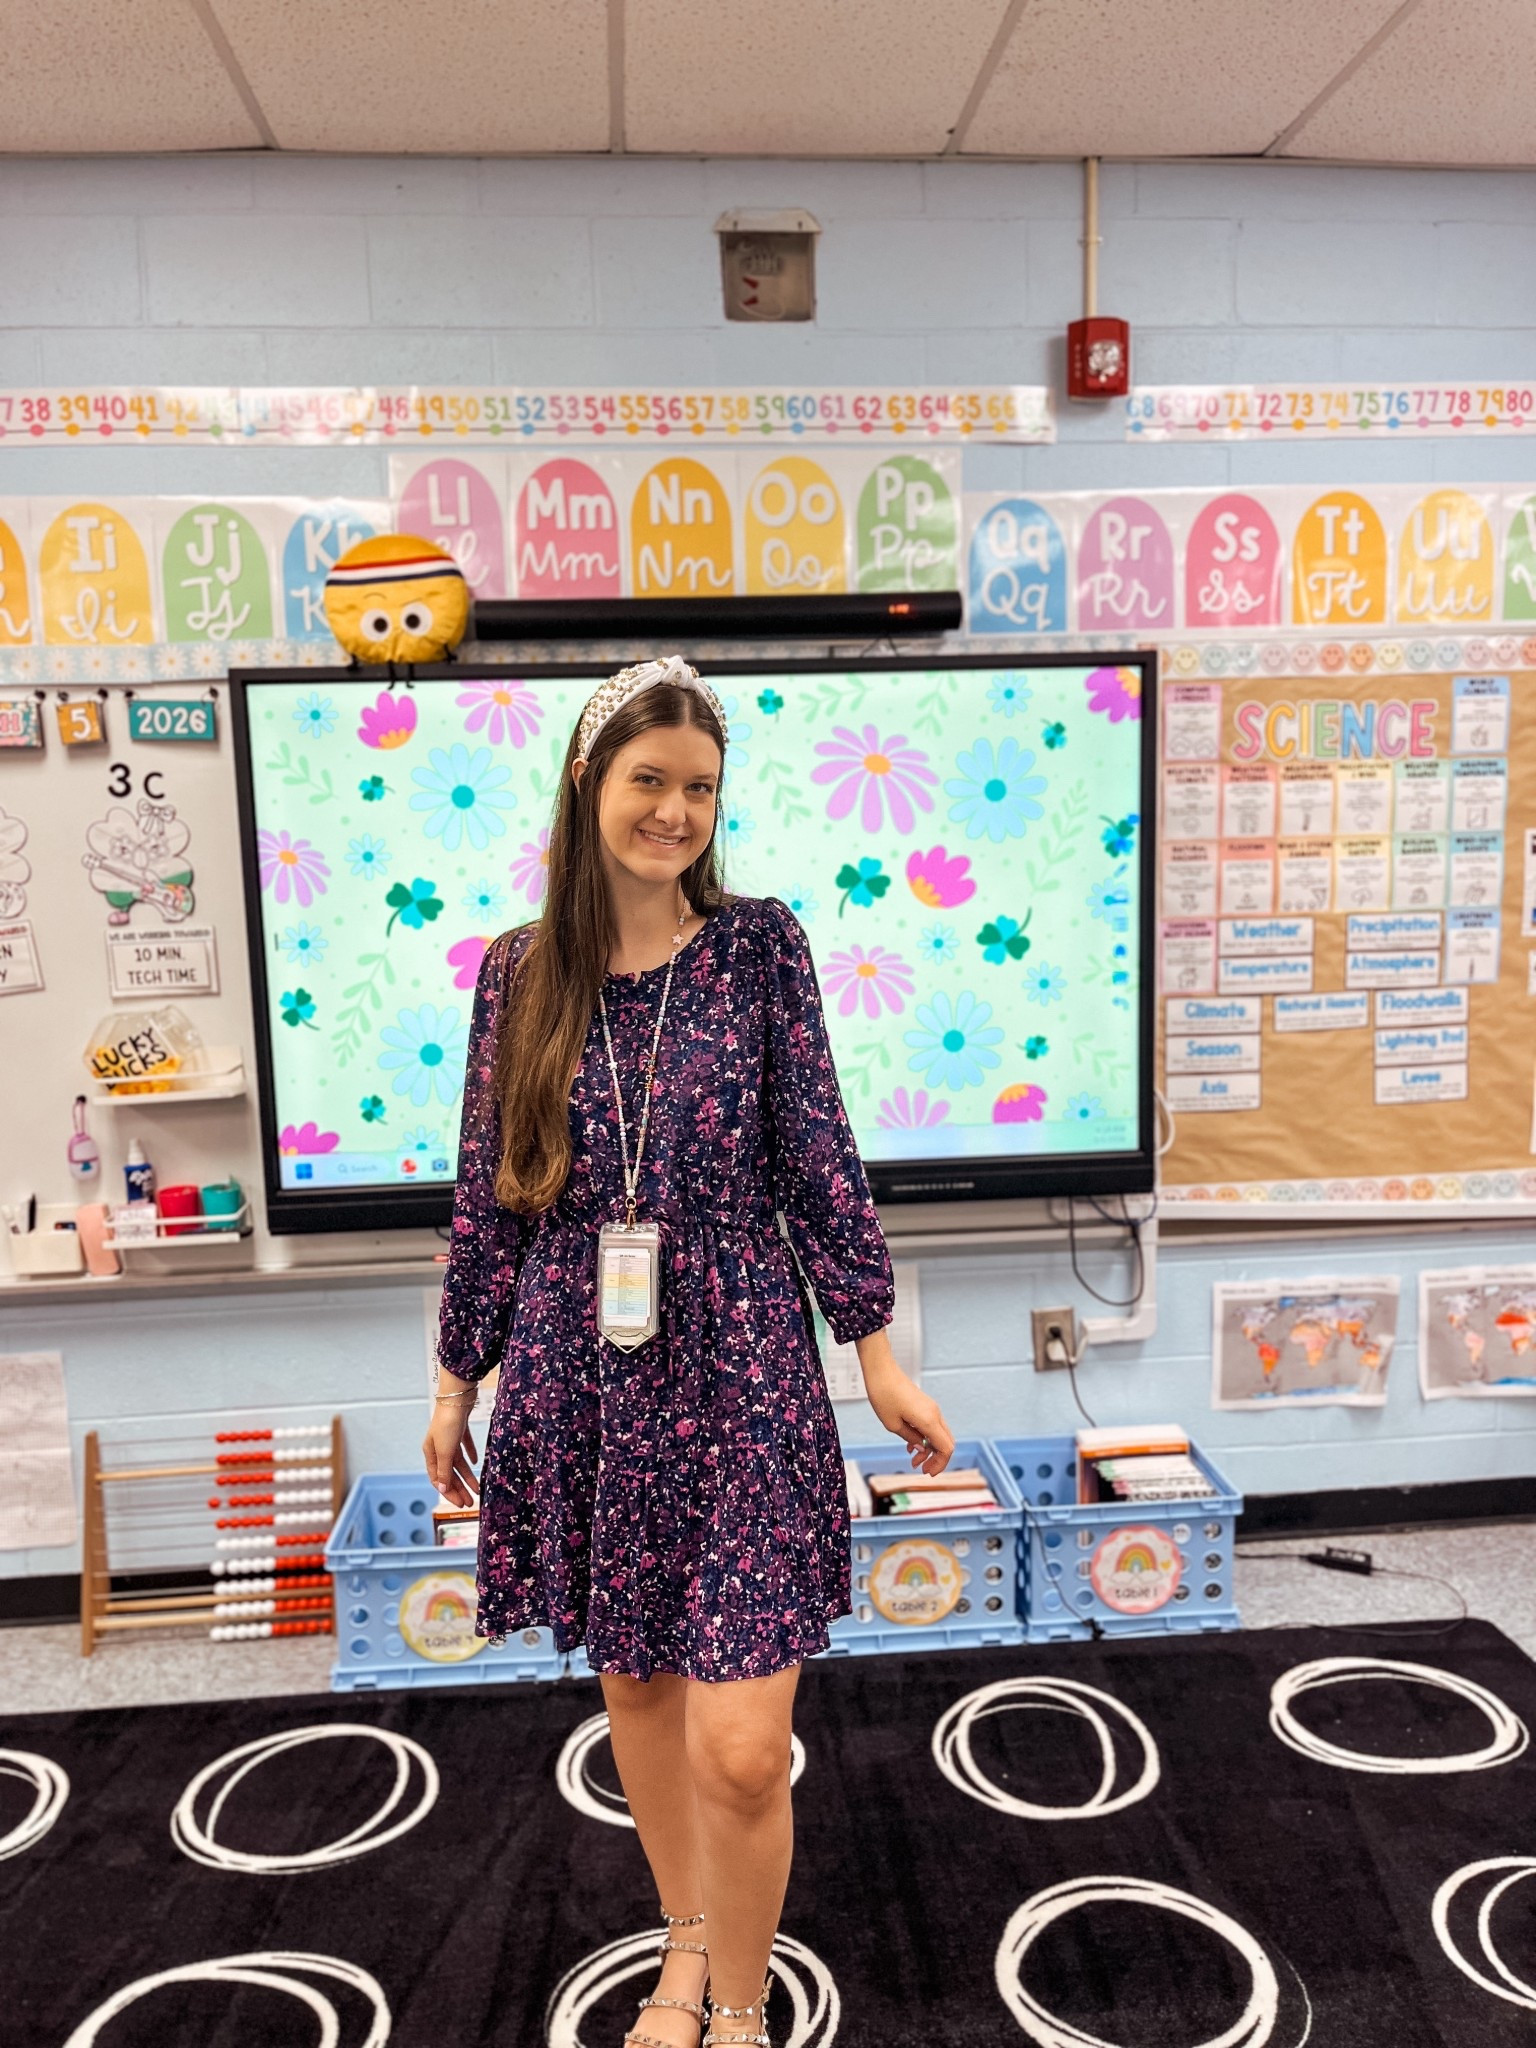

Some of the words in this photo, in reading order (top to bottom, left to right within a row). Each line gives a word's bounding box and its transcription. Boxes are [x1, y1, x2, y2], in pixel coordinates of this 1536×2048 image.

[0, 398, 13, 422] 7
[21, 397, 51, 422] 38
[57, 396, 90, 421] 39
[94, 397, 127, 421] 40
[129, 396, 159, 422] 41
[165, 398, 199, 422] 42
[272, 396, 304, 421] 45
[306, 396, 340, 421] 46
[378, 396, 410, 421] 48
[414, 396, 445, 421] 49
[448, 397, 480, 421] 50
[484, 397, 511, 421] 51
[516, 397, 546, 421] 52
[549, 396, 579, 421] 53
[584, 396, 616, 421] 54
[619, 396, 650, 421] 55
[652, 397, 682, 421] 56
[685, 396, 714, 421] 57
[720, 396, 750, 421] 58
[755, 396, 785, 420] 59
[787, 395, 816, 420] 60
[820, 395, 846, 420] 61
[852, 395, 882, 420] 62
[887, 395, 916, 420] 63
[919, 395, 949, 420] 64
[952, 395, 982, 420] 65
[986, 395, 1017, 420] 66
[1126, 395, 1155, 418] 68
[1158, 394, 1189, 418] 69
[1193, 394, 1220, 418] 70
[1223, 392, 1249, 417] 71
[1255, 392, 1282, 417] 72
[1286, 392, 1314, 417] 73
[1319, 391, 1348, 416] 74
[1353, 391, 1380, 415] 75
[1382, 391, 1410, 415] 76
[1412, 390, 1439, 414] 77
[1444, 390, 1471, 414] 78
[1477, 389, 1505, 413] 79
[1507, 390, 1534, 413] 80
[526, 477, 614, 531] Mm
[648, 473, 714, 527] Nn
[751, 470, 837, 528] Oo
[876, 466, 935, 532] Pp
[66, 516, 117, 573] Ii
[186, 514, 242, 585] Jj
[988, 509, 1050, 574] Qq
[1100, 511, 1153, 562] Rr
[1212, 511, 1262, 564] Ss
[1316, 505, 1365, 556] Tt
[1412, 506, 1481, 562] Uu
[519, 541, 620, 582] Mm
[639, 541, 732, 590] Nn
[762, 538, 834, 588] Oo
[869, 523, 946, 591] Pp
[180, 576, 251, 642] Jj
[982, 567, 1052, 632] Qq
[1077, 571, 1167, 619] Rr
[1199, 568, 1266, 614] Ss
[1307, 569, 1371, 618] Tt
[1403, 571, 1490, 616] Uu
[70, 707, 92, 740] 5
[136, 706, 207, 734] 2026
[1232, 701, 1437, 760] SCIENCE
[107, 762, 132, 798] 3
[1232, 922, 1302, 938] Weather
[1350, 918, 1440, 936] Precipitation
[128, 970, 162, 985] TECH
[166, 968, 197, 983] TIME
[134, 948, 152, 962] 10
[1223, 961, 1309, 978] Temperature
[1351, 955, 1435, 973] Atmosphere
[1184, 1002, 1246, 1019] Climate
[1381, 992, 1462, 1010] Floodwalls
[92, 1027, 153, 1073] LUCKY
[1186, 1040, 1242, 1057] Season
[1378, 1032, 1437, 1050] Lightning
[1201, 1080, 1228, 1094] Axis
[1402, 1071, 1441, 1084] Levee
[930, 1601, 938, 1611] 2
